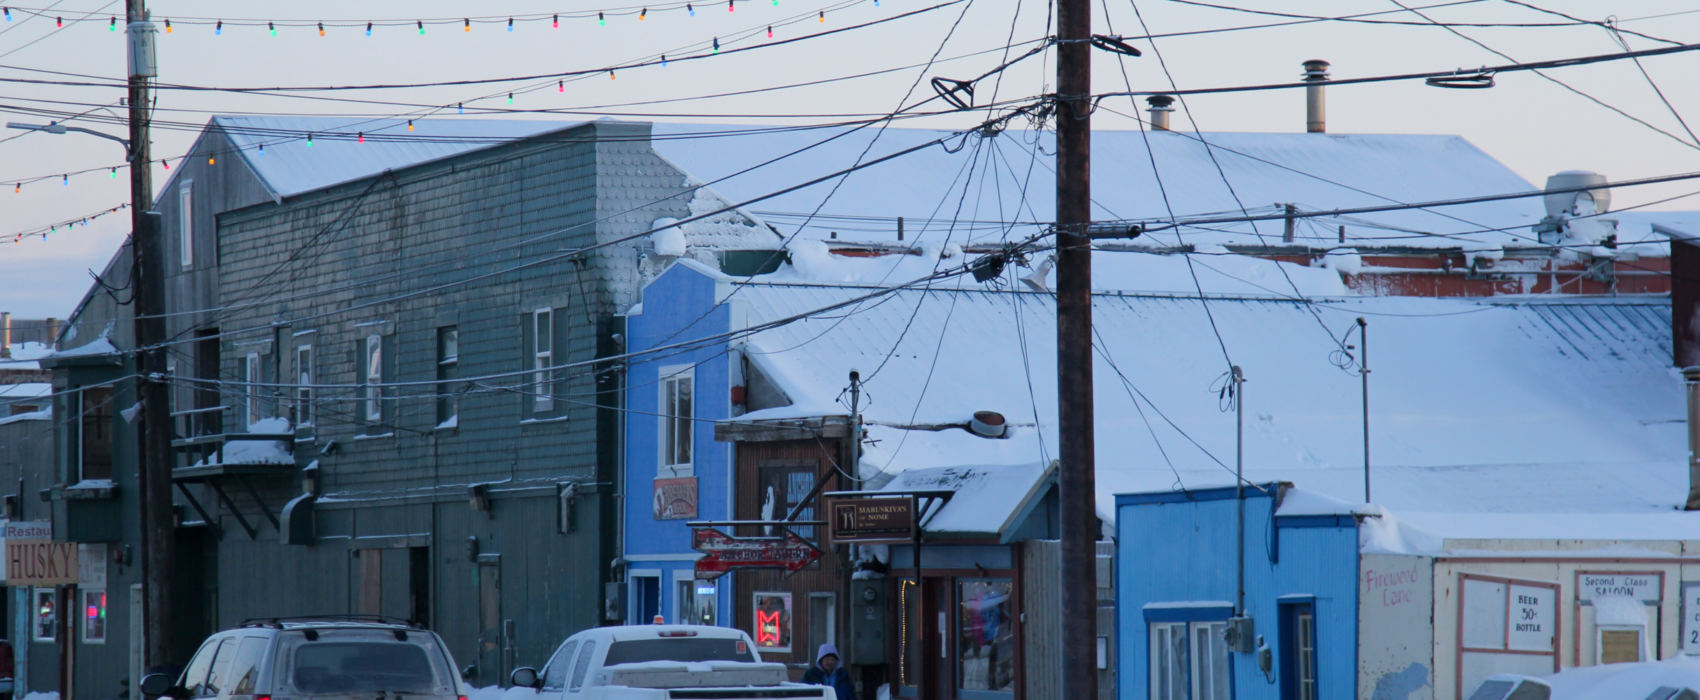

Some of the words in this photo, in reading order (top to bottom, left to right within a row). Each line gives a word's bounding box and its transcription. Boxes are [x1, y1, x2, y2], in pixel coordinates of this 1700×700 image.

[867, 513, 890, 521] NOME
[9, 543, 74, 580] HUSKY
[1584, 576, 1615, 586] Second
[1624, 576, 1649, 586] Class
[1518, 594, 1539, 605] BEER
[1515, 623, 1542, 632] BOTTLE
